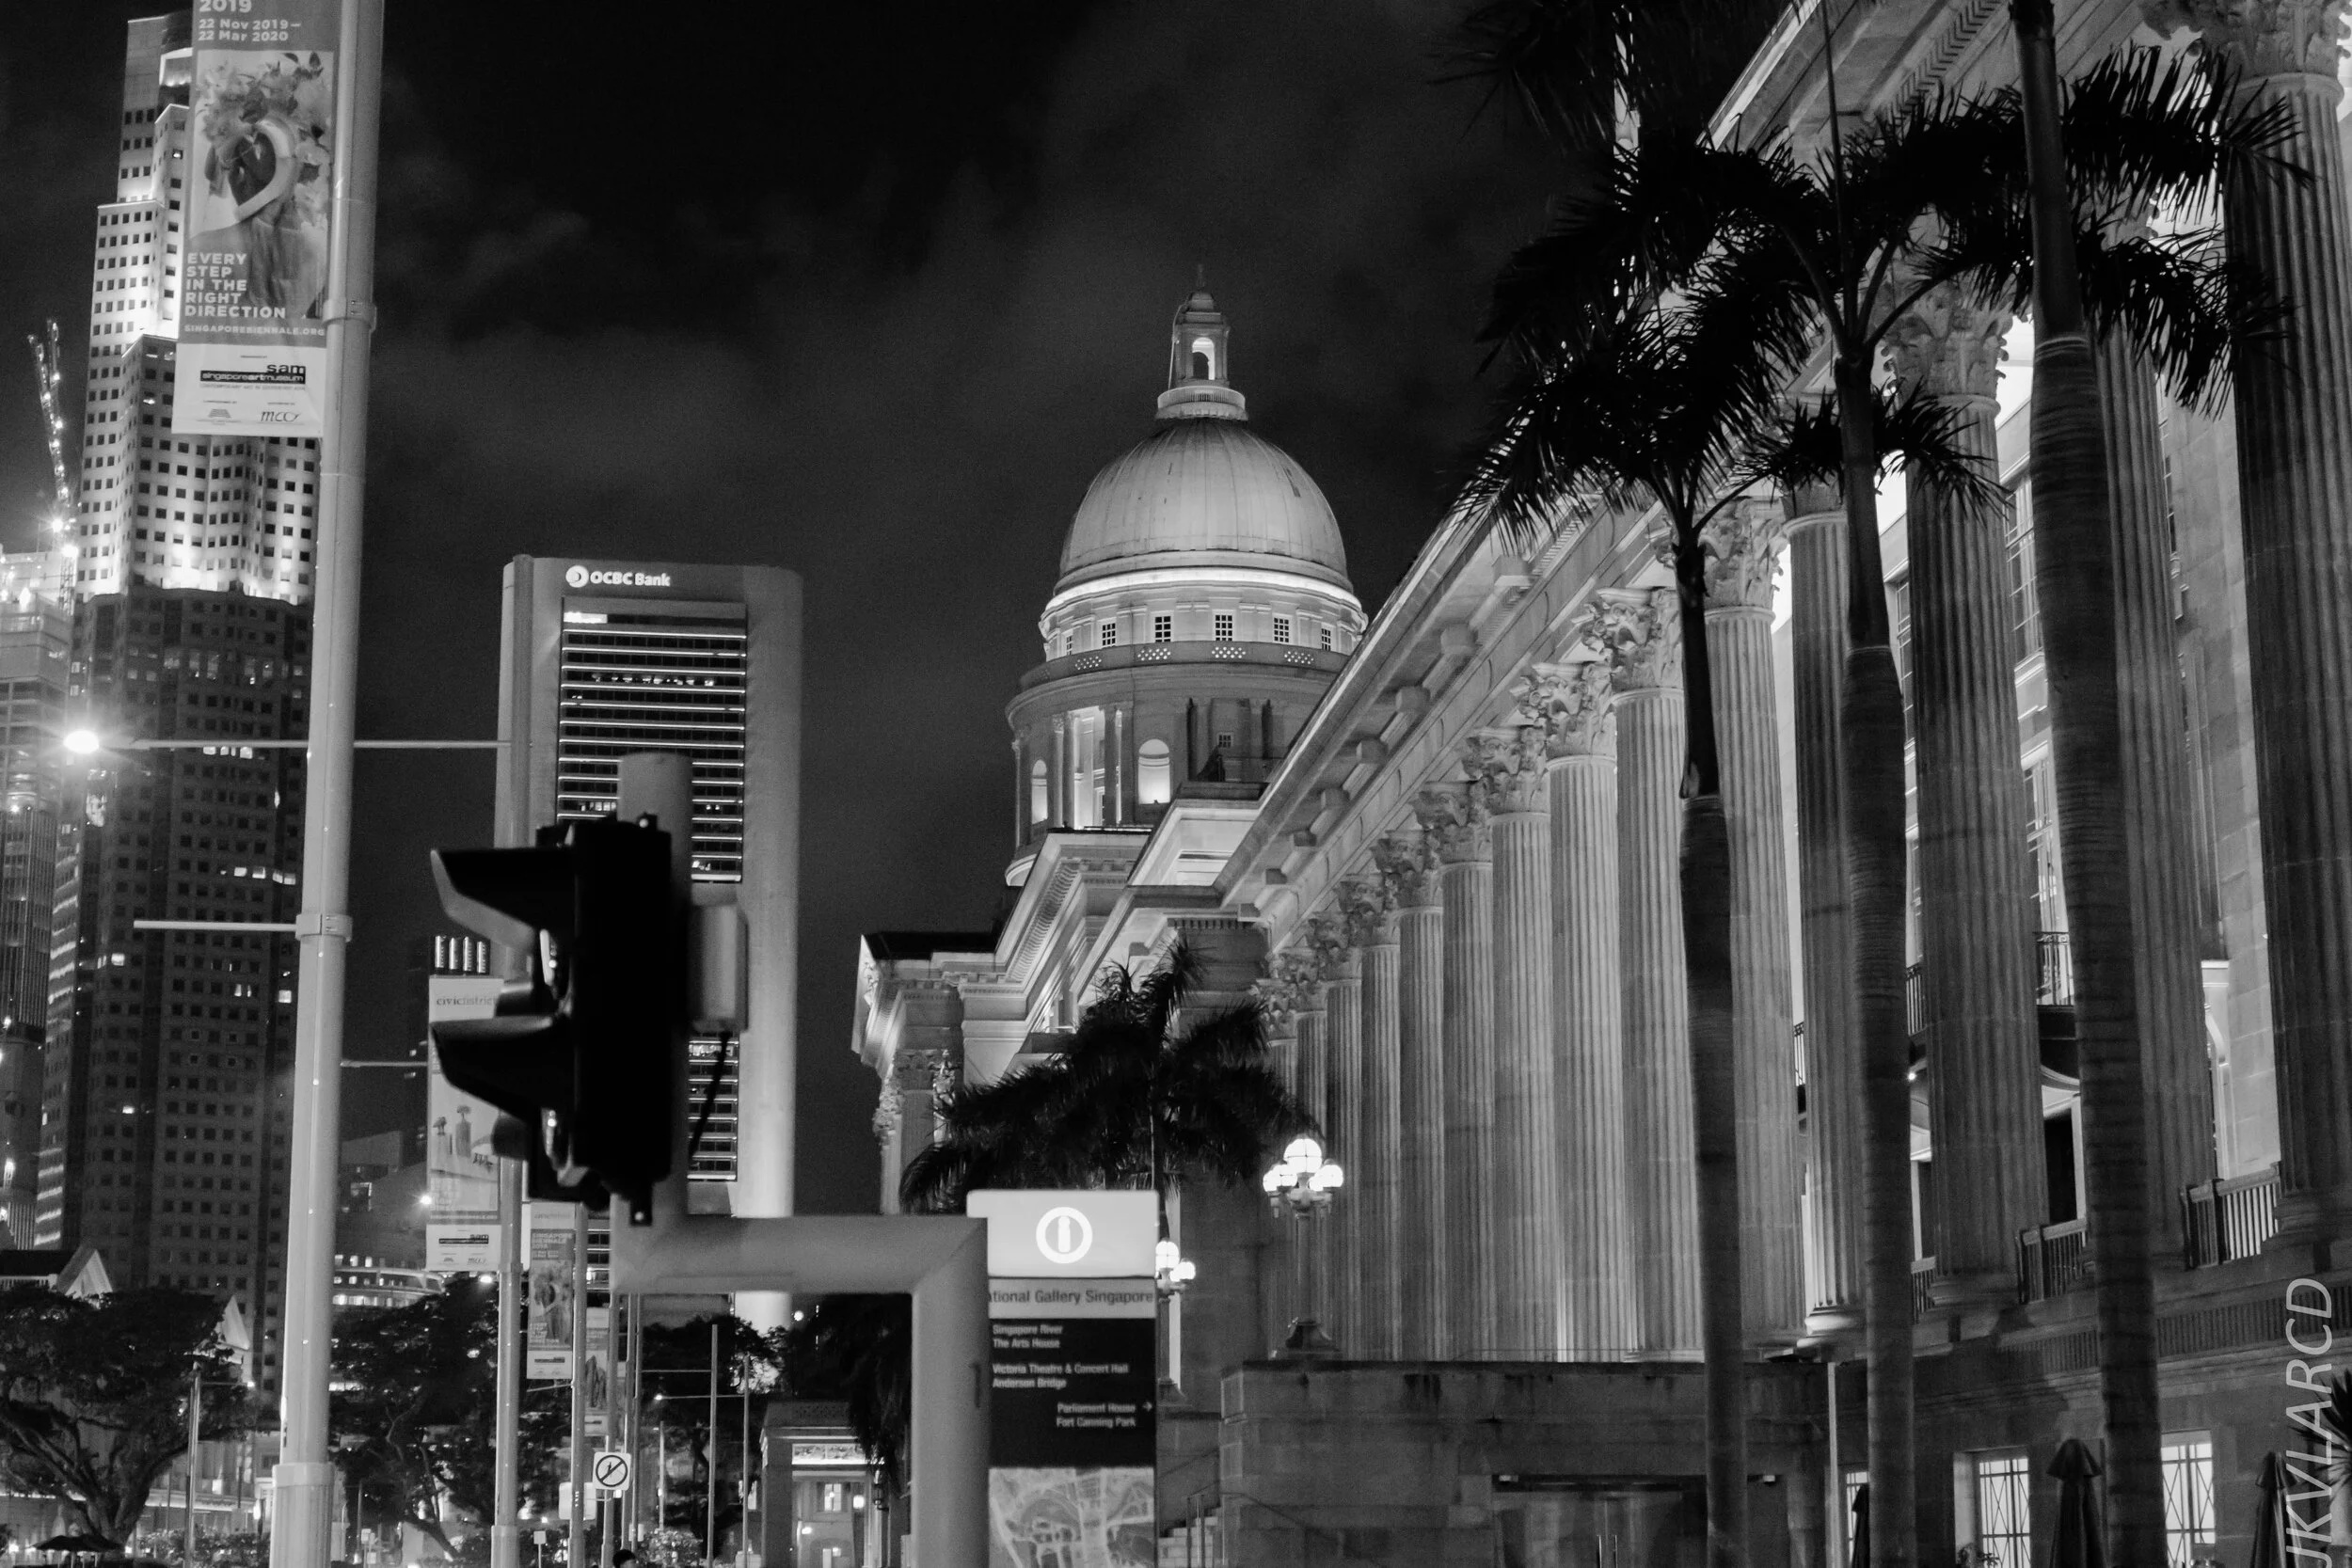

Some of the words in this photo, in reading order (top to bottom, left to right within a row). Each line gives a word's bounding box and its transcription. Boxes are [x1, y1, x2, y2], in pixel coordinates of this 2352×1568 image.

[199, 0, 252, 13] 2019
[199, 19, 215, 29] 22
[219, 19, 248, 30] Nov
[198, 30, 215, 40] 22
[218, 31, 247, 41] Mar
[252, 31, 289, 41] 2020
[188, 252, 247, 265] EVERY
[186, 266, 232, 277] STEP
[186, 279, 204, 291] IN
[212, 279, 246, 292] THE
[185, 293, 242, 304] RIGHT
[184, 306, 286, 319] DIRECTION
[266, 364, 306, 374] sam
[590, 571, 633, 586] OCBC
[634, 572, 671, 587] Bank
[1035, 1290, 1081, 1306] Gallery
[1086, 1290, 1153, 1306] Singapore
[993, 1324, 1038, 1337] Singapore
[1040, 1324, 1063, 1335] River
[993, 1338, 1009, 1349] The
[1011, 1338, 1030, 1349] Arts
[1032, 1338, 1060, 1349] House
[993, 1364, 1026, 1374] Victoria
[1029, 1364, 1062, 1374] Theatre
[1074, 1364, 1108, 1374] Concert
[1111, 1364, 1129, 1374] Hall
[993, 1378, 1035, 1388] Anderson
[1037, 1378, 1067, 1390] Bridge
[1057, 1402, 1105, 1413] Parliament
[1108, 1402, 1136, 1413] House
[1057, 1418, 1074, 1428] Fort
[1077, 1418, 1113, 1429] Canning
[1115, 1418, 1136, 1428] Park
